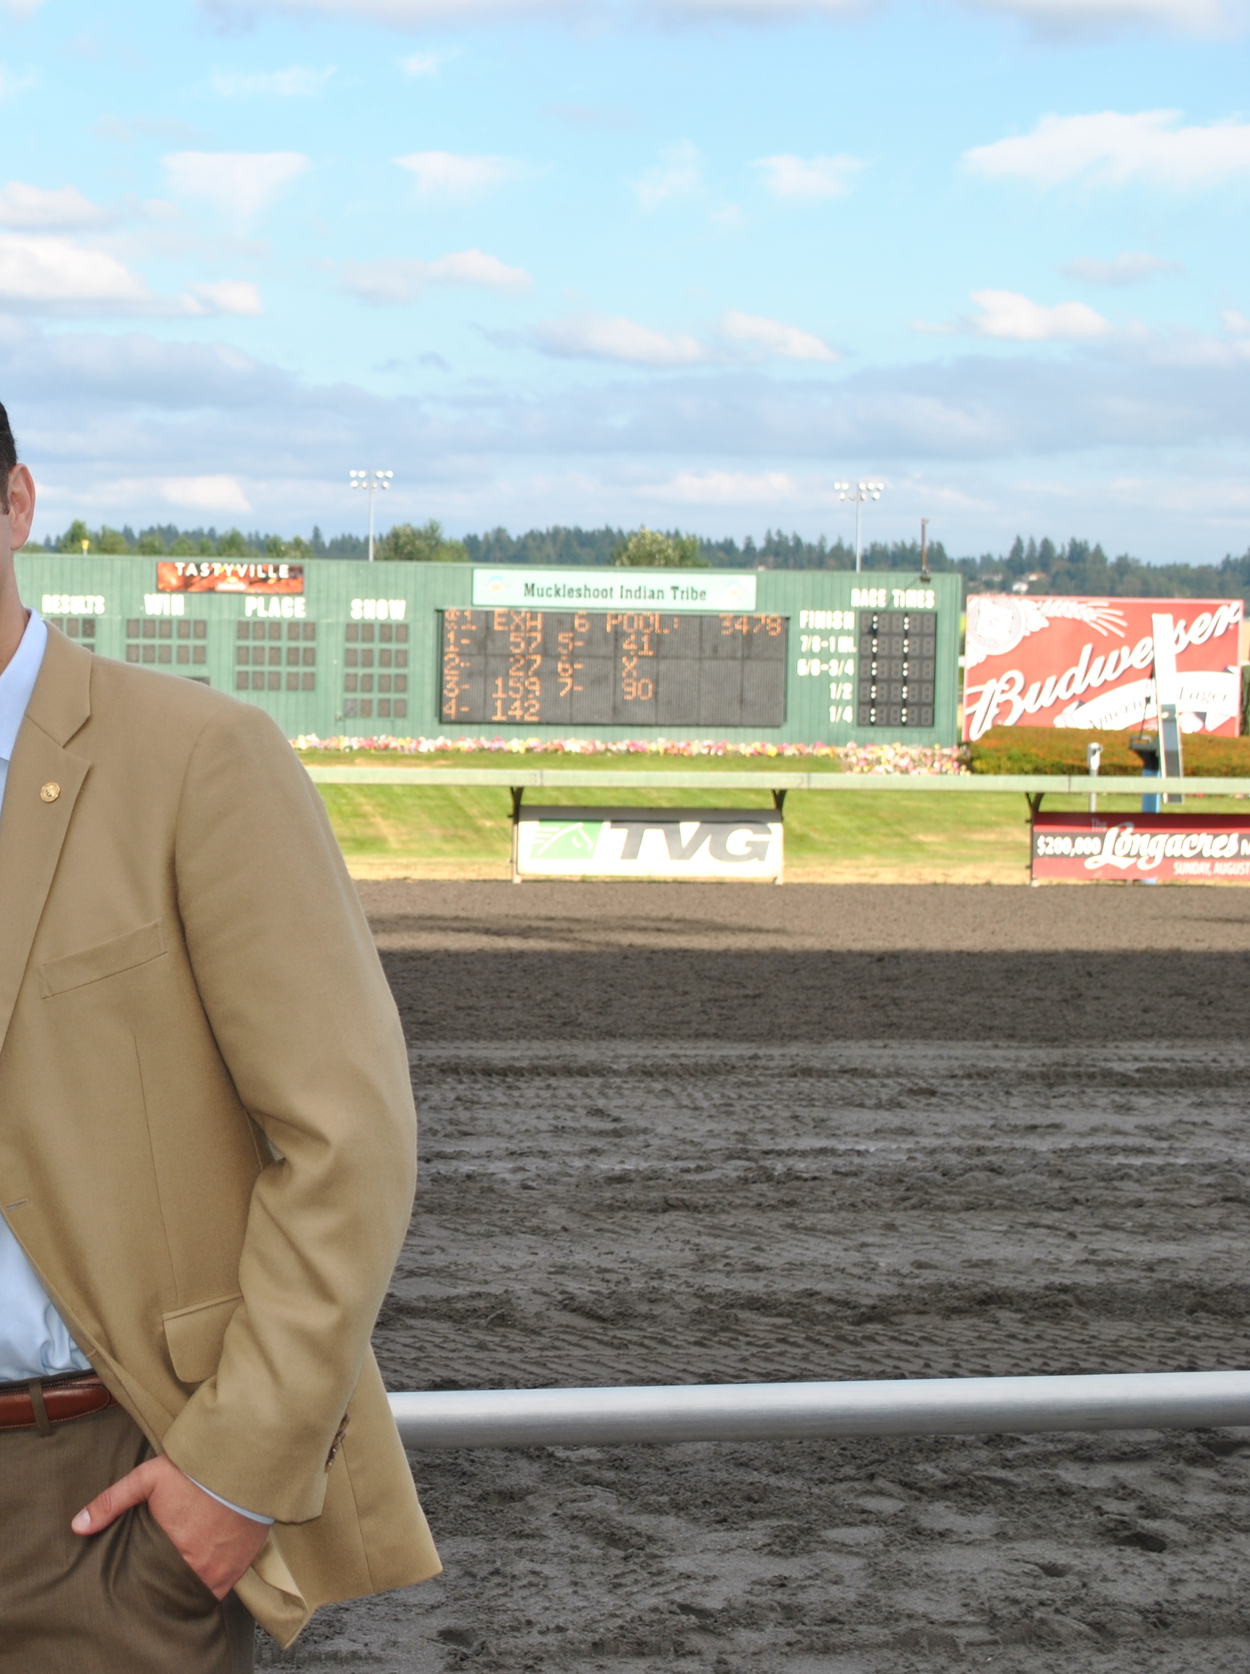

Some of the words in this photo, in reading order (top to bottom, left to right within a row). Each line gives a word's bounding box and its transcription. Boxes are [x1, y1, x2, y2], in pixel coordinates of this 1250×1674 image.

[174, 562, 290, 579] TASTYVILLE
[523, 582, 614, 600] Muckleshoot
[619, 584, 665, 601] Indian
[670, 585, 707, 601] Tribe
[850, 588, 887, 608] RACE
[891, 588, 936, 609] TIMES
[41, 594, 106, 615] RESULTS
[143, 593, 185, 616] WIN
[244, 595, 307, 619] PLACE
[350, 598, 407, 620] SHOW
[799, 610, 856, 630] FINISH
[509, 631, 542, 654] 57
[509, 654, 542, 676] 27
[965, 600, 1242, 741] Budweser
[491, 676, 541, 699] 159
[829, 682, 854, 700] 1/2
[491, 698, 541, 721] 142
[828, 705, 854, 723] 1/4
[609, 819, 773, 863] TVG
[1036, 834, 1102, 858] $200,000
[1083, 821, 1240, 871] Longacres
[1213, 860, 1250, 876] AUGUST
